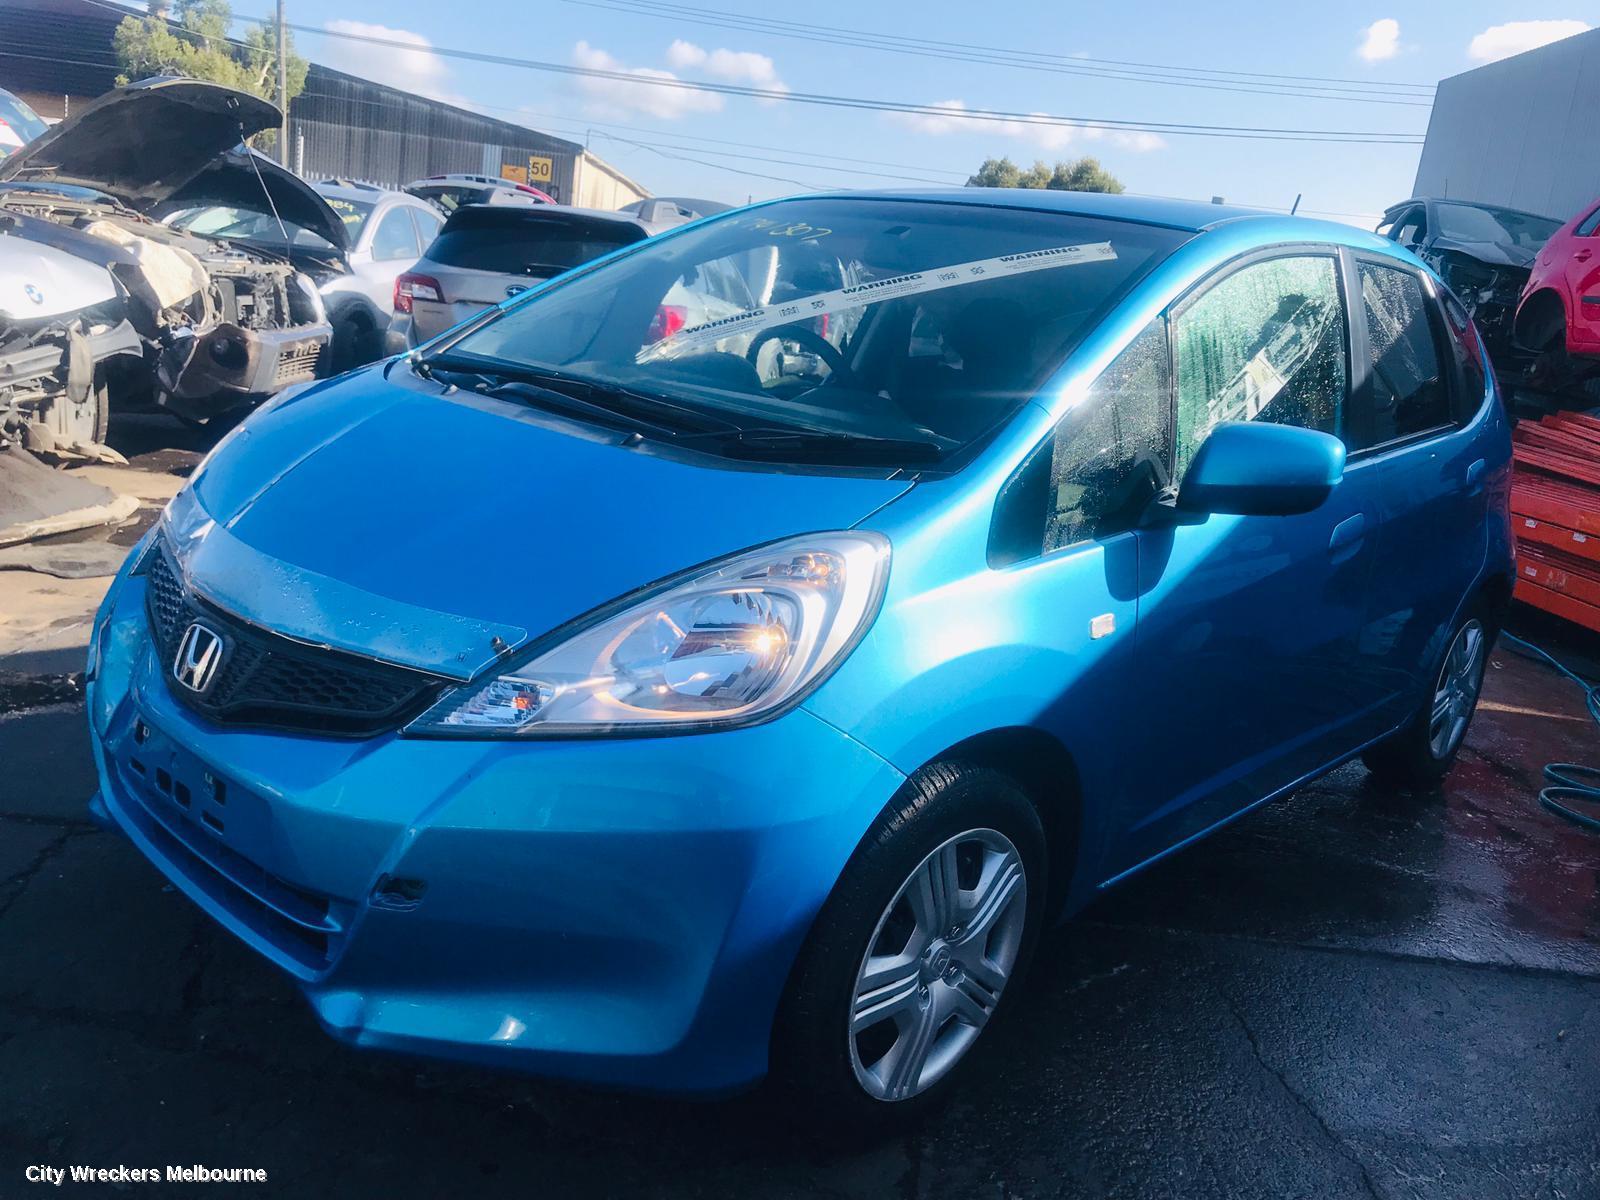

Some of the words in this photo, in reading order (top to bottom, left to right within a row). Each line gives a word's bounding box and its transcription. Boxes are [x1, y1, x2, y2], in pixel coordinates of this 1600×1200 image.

[531, 161, 549, 177] 50
[1000, 246, 1081, 263] WARNING
[842, 273, 923, 295] WARNING
[685, 309, 765, 335] WARNING
